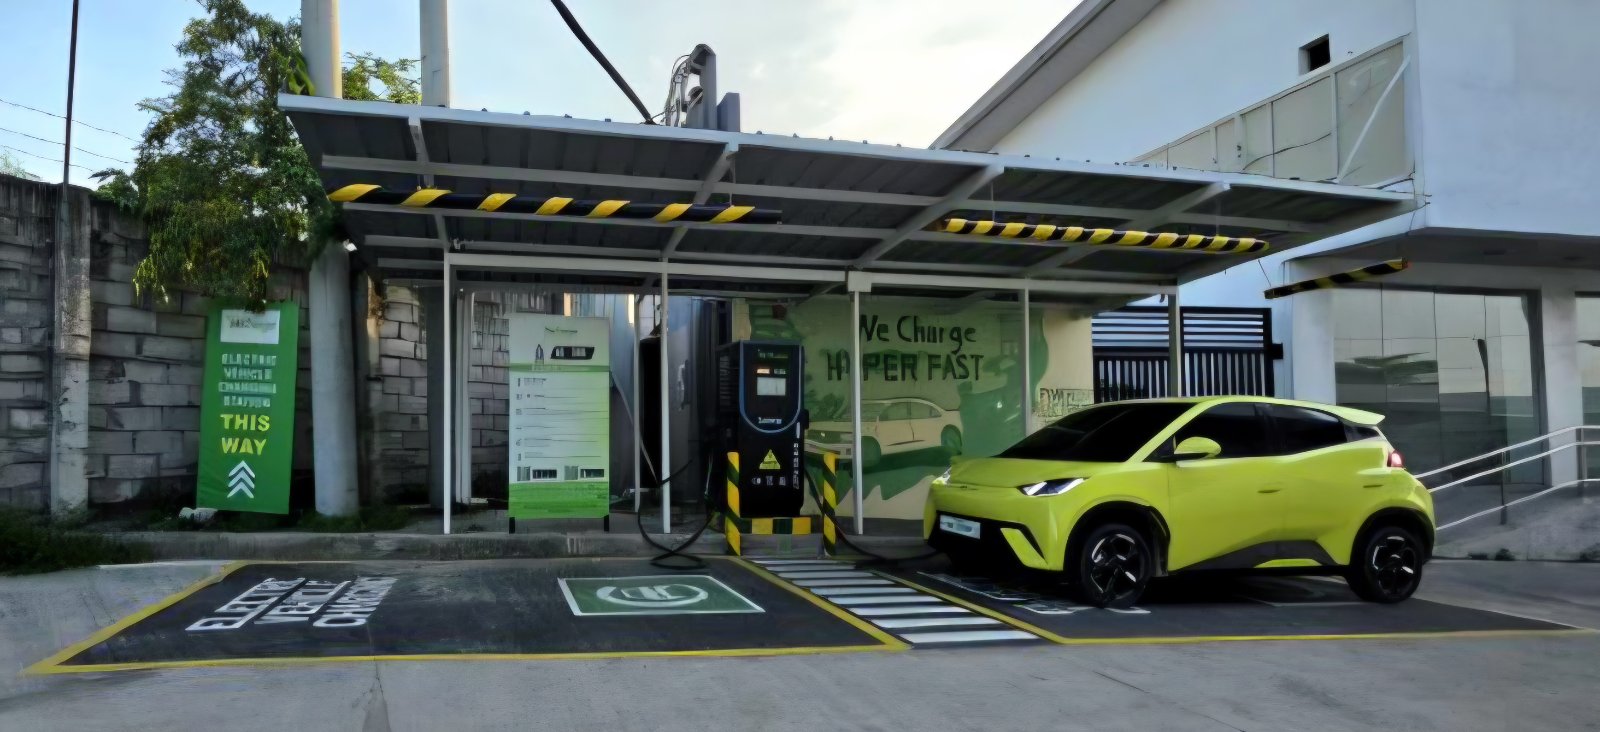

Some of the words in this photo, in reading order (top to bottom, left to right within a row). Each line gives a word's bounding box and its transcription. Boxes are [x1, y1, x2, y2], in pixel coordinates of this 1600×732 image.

[859, 314, 890, 342] We
[927, 353, 985, 382] FAST
[219, 413, 271, 432] THIS
[220, 437, 268, 456] WAY
[185, 577, 306, 631] ELECT
